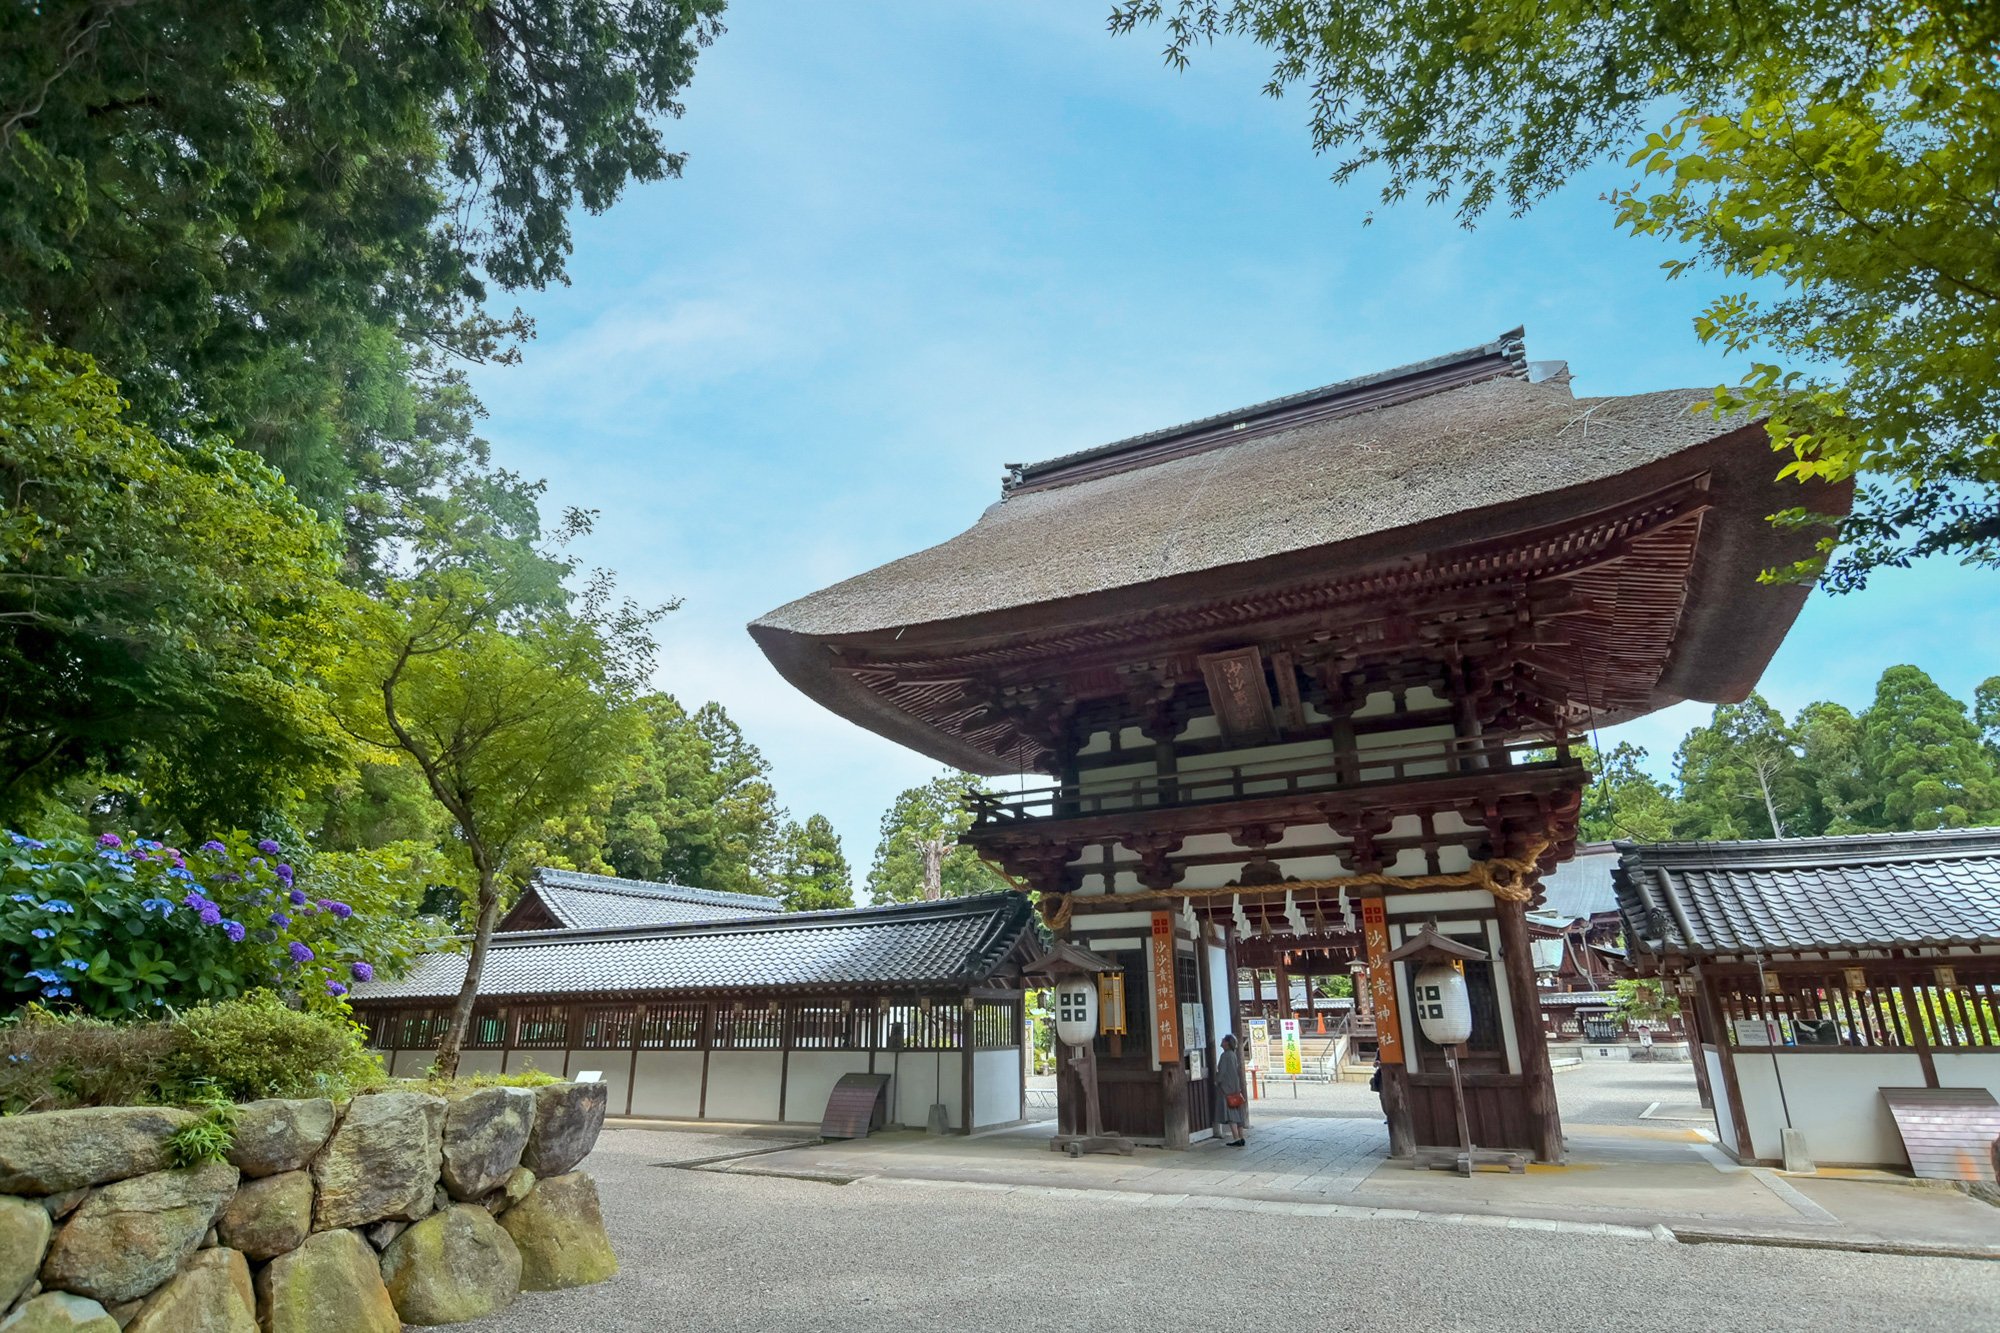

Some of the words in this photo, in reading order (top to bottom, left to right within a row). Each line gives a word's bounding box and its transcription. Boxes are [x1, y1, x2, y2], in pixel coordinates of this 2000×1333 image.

[1154, 940, 1170, 1010] 沙沙貴神社
[1367, 929, 1396, 1047] 沙沙貴神社
